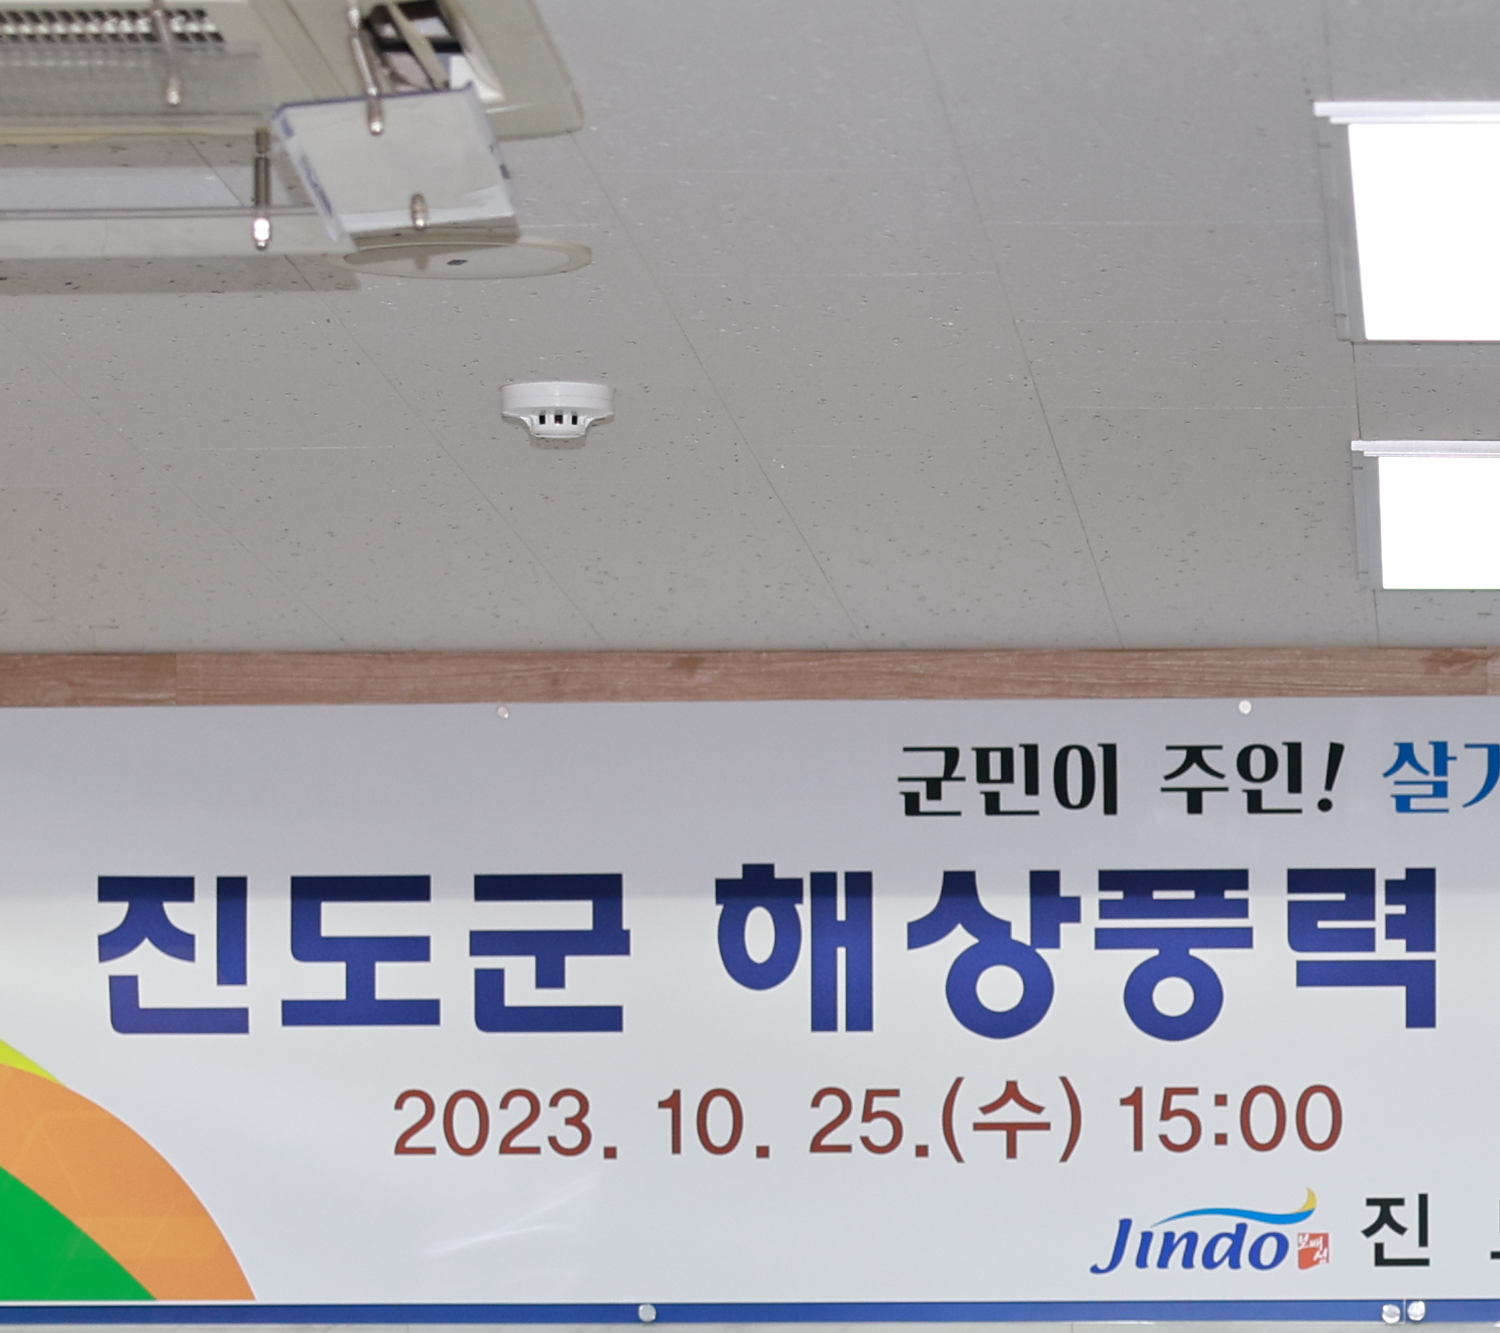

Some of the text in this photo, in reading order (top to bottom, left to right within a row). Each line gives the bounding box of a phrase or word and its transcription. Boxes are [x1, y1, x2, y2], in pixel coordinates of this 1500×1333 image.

[896, 742, 1119, 818] 군민이
[1159, 740, 1347, 816] 주인!
[96, 872, 632, 1036] 진도군
[713, 862, 1438, 1042] 해상풍력
[392, 1087, 619, 1160] 2023.
[656, 1087, 771, 1159] 10.
[1118, 1084, 1344, 1154] 15:00
[1089, 1217, 1290, 1276] Jindo
